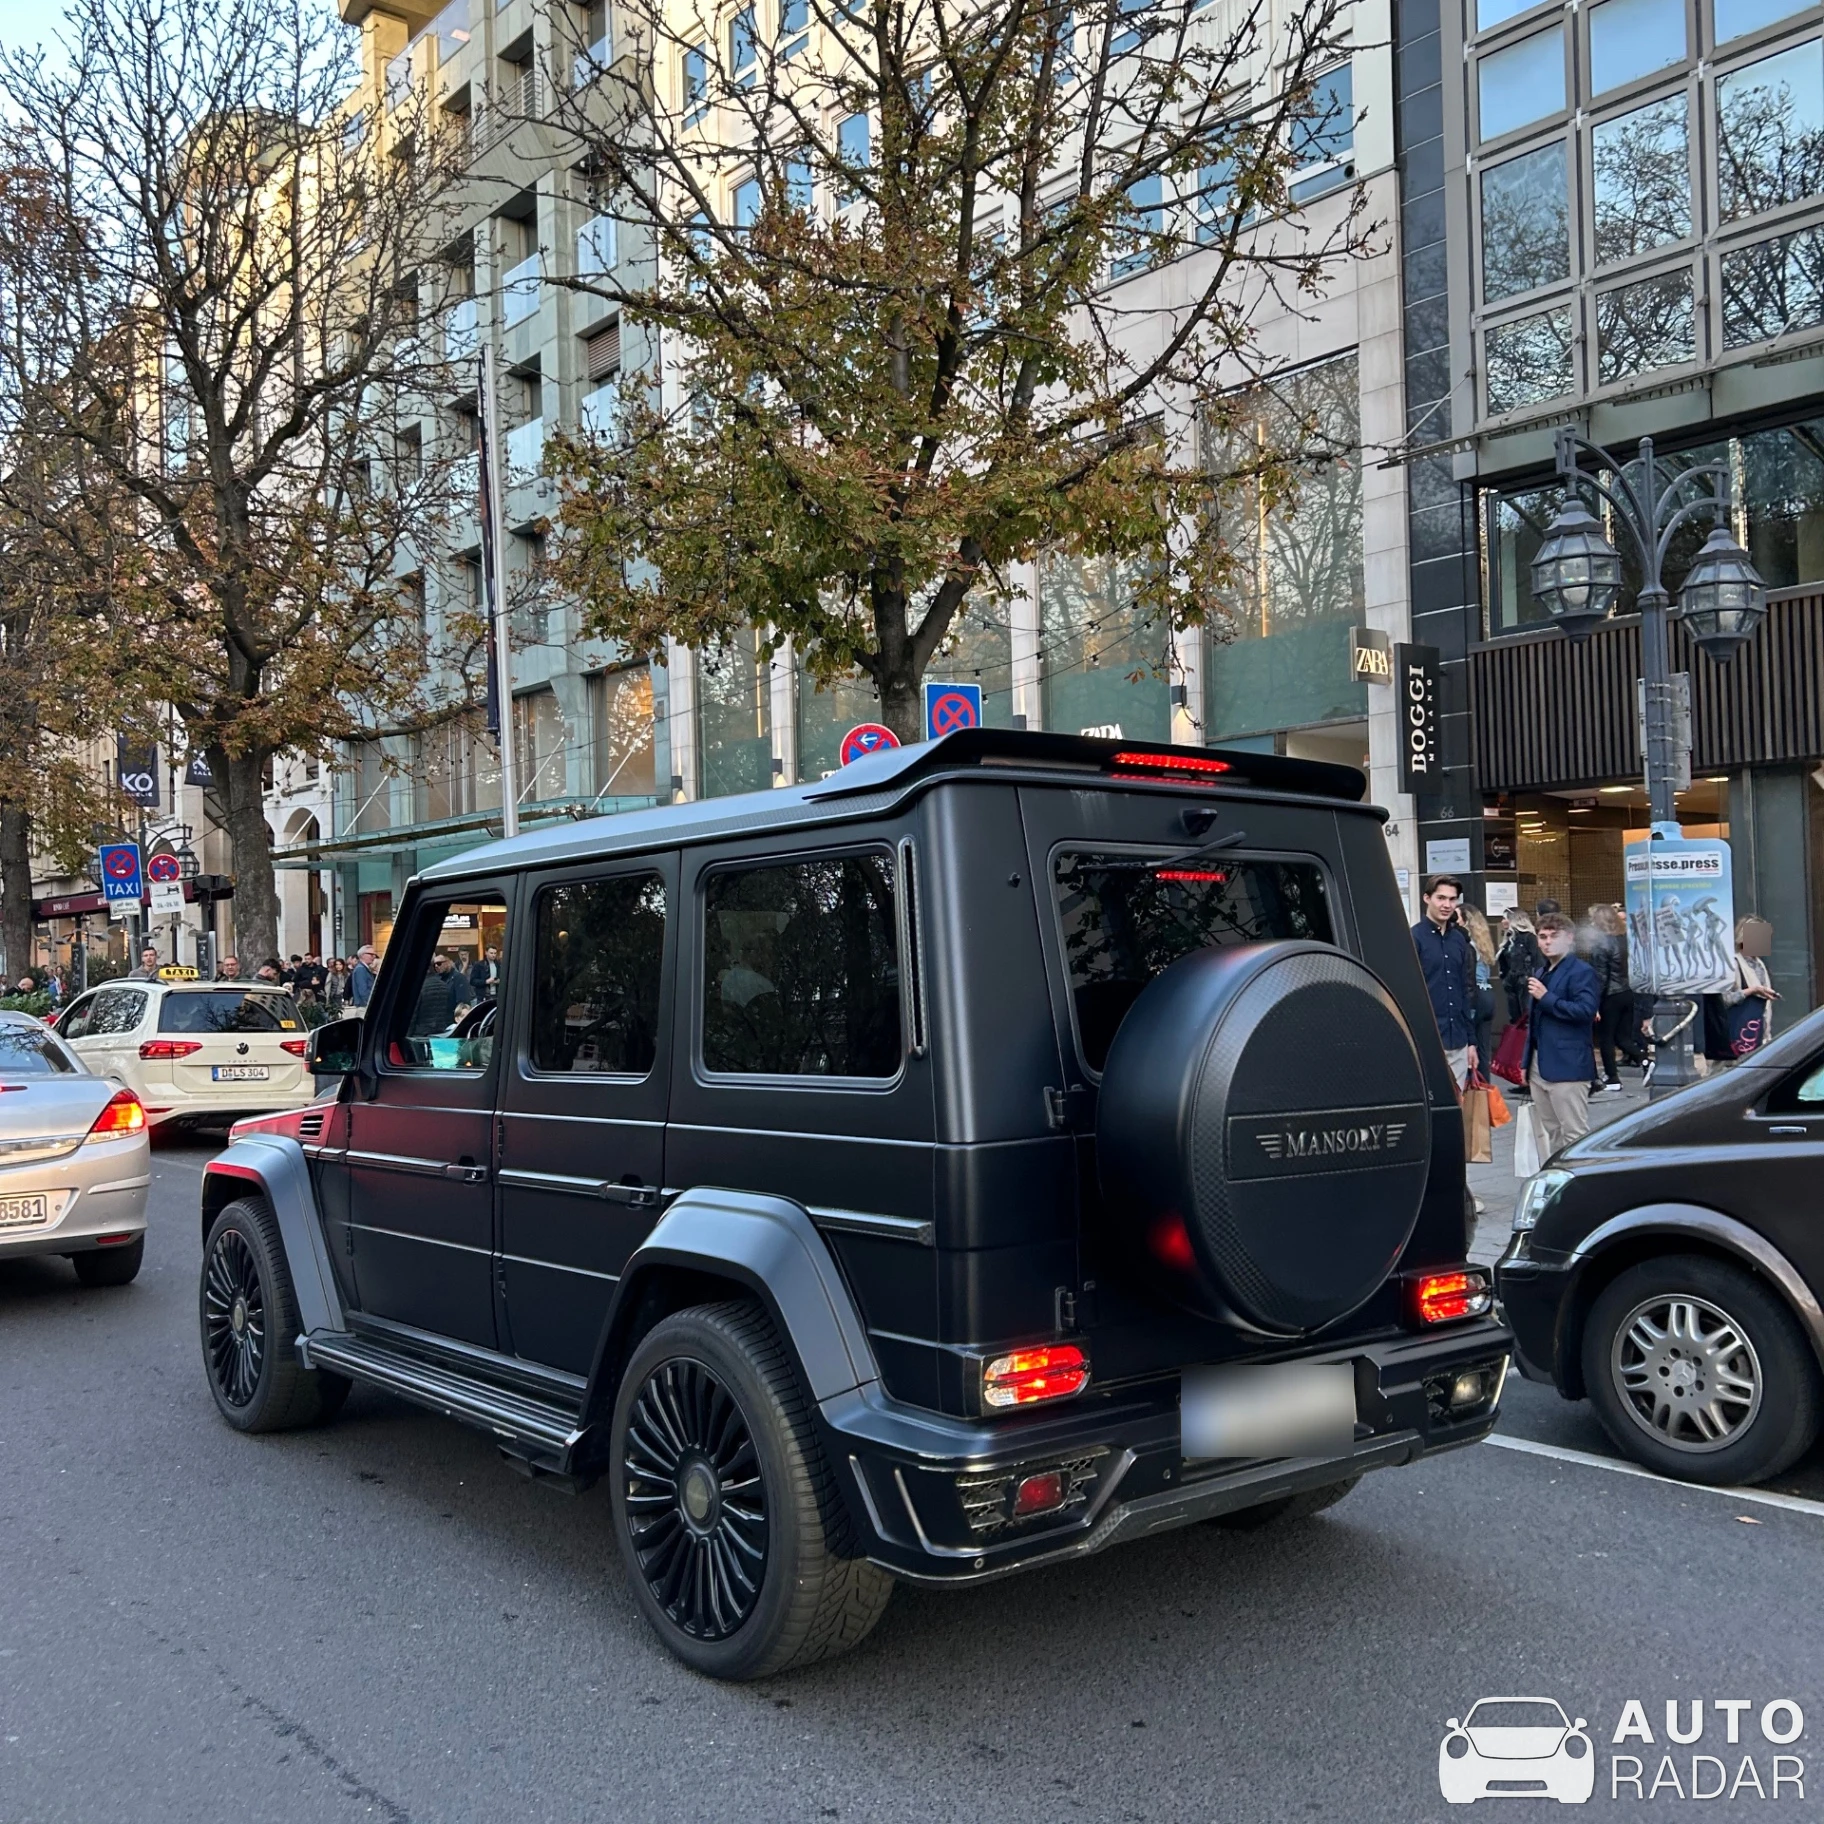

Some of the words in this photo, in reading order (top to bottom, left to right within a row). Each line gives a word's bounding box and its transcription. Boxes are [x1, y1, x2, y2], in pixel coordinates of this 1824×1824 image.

[1409, 665, 1427, 773] BOGGI
[1427, 679, 1435, 761] MILANO
[1440, 806, 1455, 818] 66
[1385, 824, 1399, 837] 64
[107, 882, 139, 896] TAXI
[169, 968, 193, 976] TAXI
[222, 1068, 228, 1077] D
[247, 1067, 264, 1077] 304
[1286, 1124, 1384, 1158] MANSORY
[0, 1199, 43, 1220] 8581
